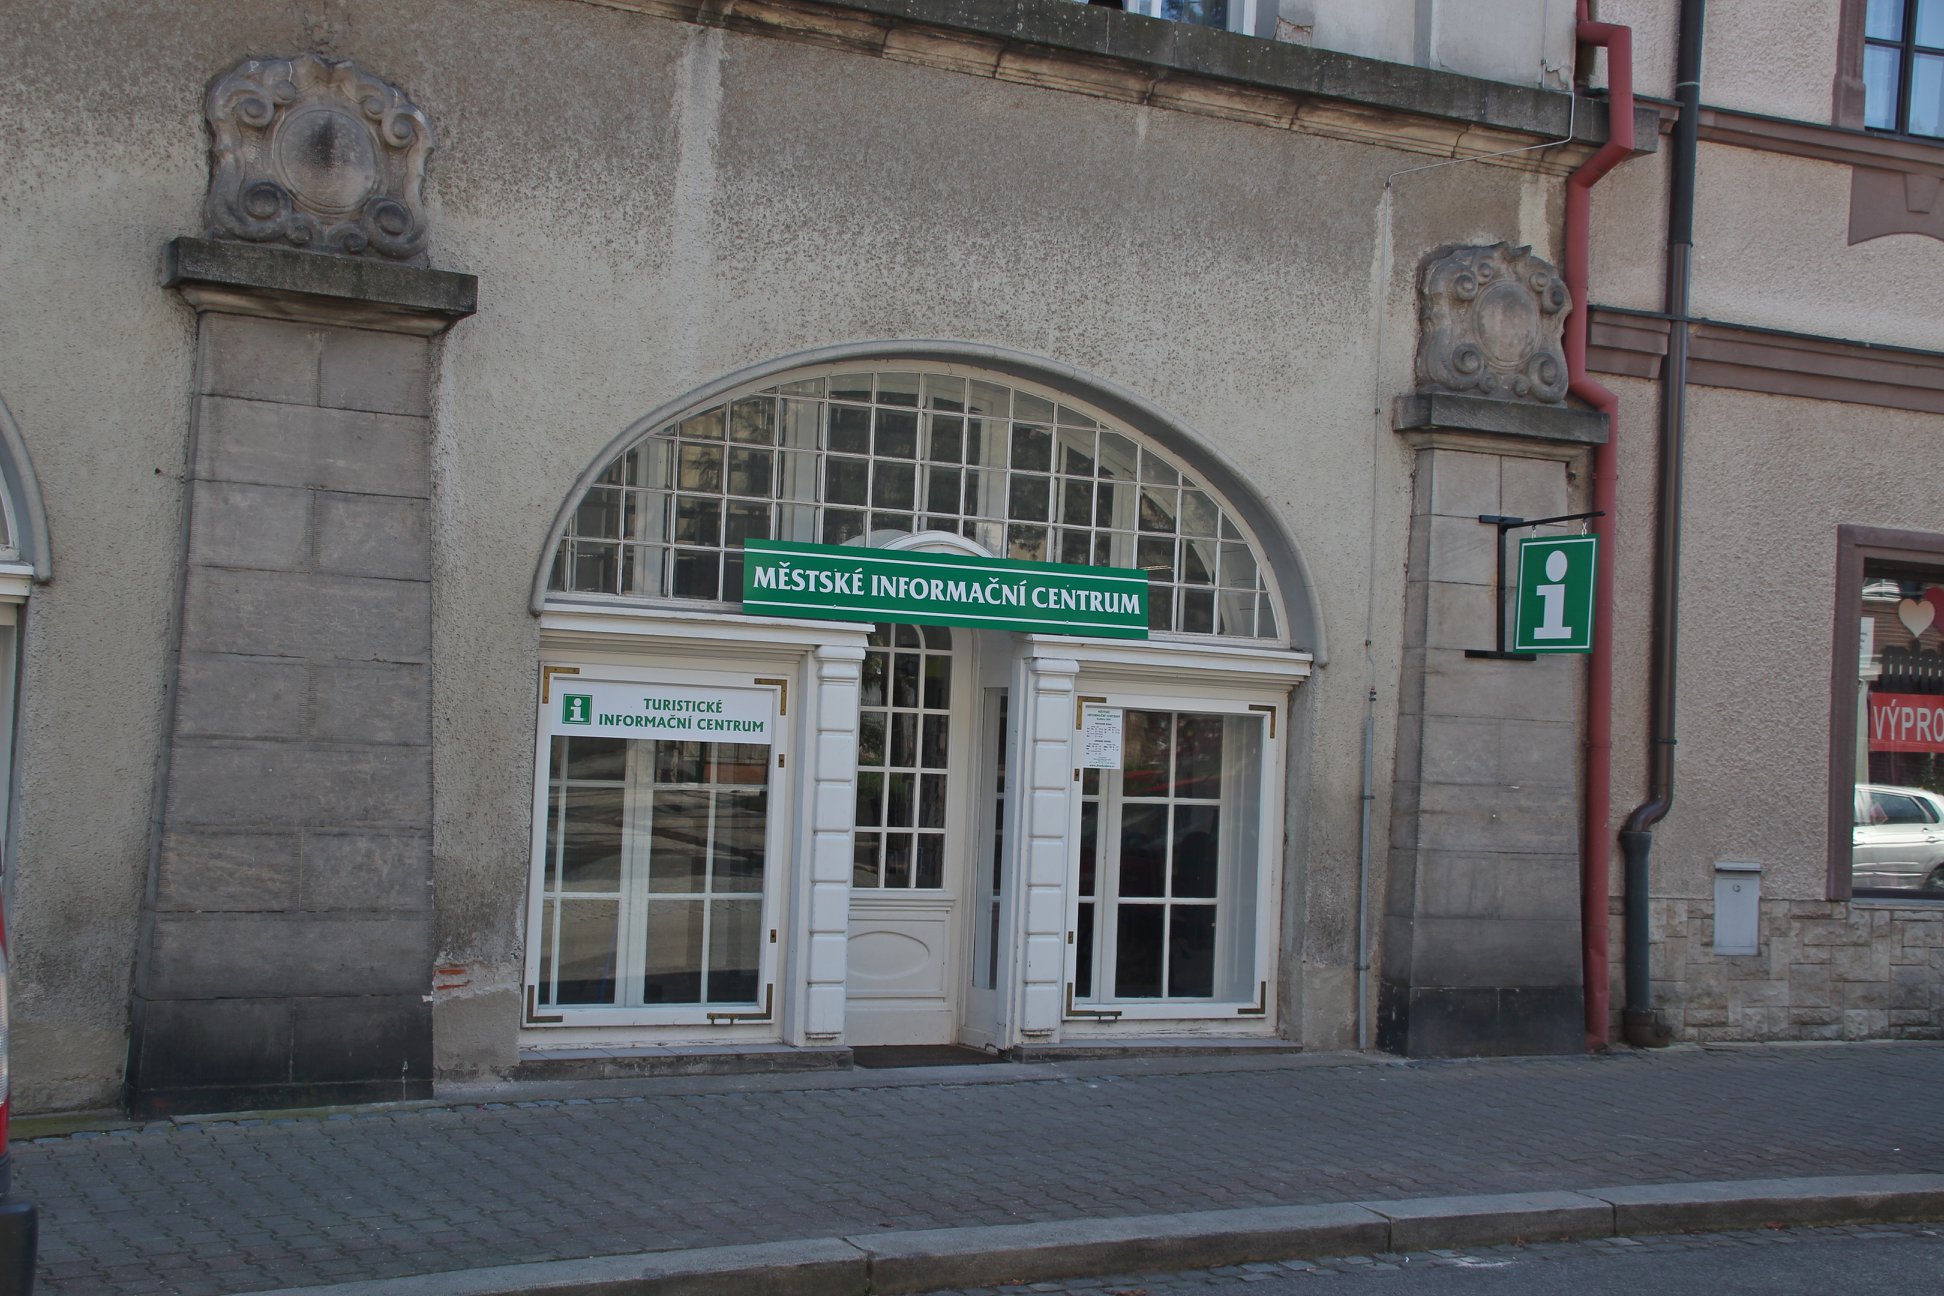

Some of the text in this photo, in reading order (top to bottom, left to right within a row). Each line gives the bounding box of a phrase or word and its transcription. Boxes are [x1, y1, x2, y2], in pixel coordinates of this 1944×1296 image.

[753, 561, 1141, 615] MĚSTSKÉ INFORMAČNÍ CENTRUM
[643, 698, 723, 713] TURISTICKÉ
[599, 714, 764, 733] INFORMAČNÍ CENTRUM
